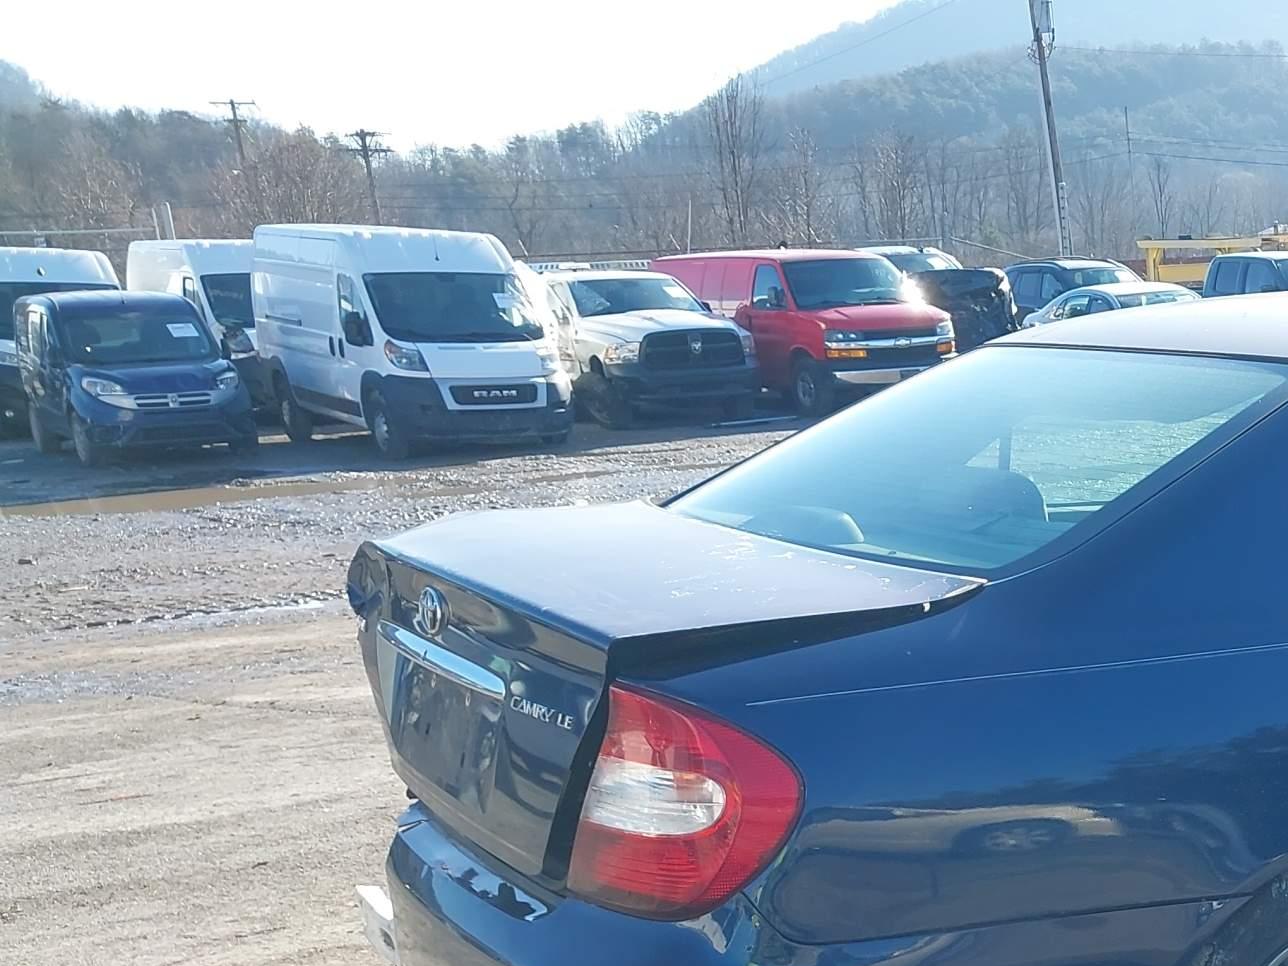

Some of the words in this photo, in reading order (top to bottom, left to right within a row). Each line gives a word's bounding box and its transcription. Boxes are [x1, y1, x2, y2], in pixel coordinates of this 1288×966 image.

[473, 390, 517, 398] RAM
[510, 695, 556, 722] CAMRY
[556, 713, 574, 730] LE
